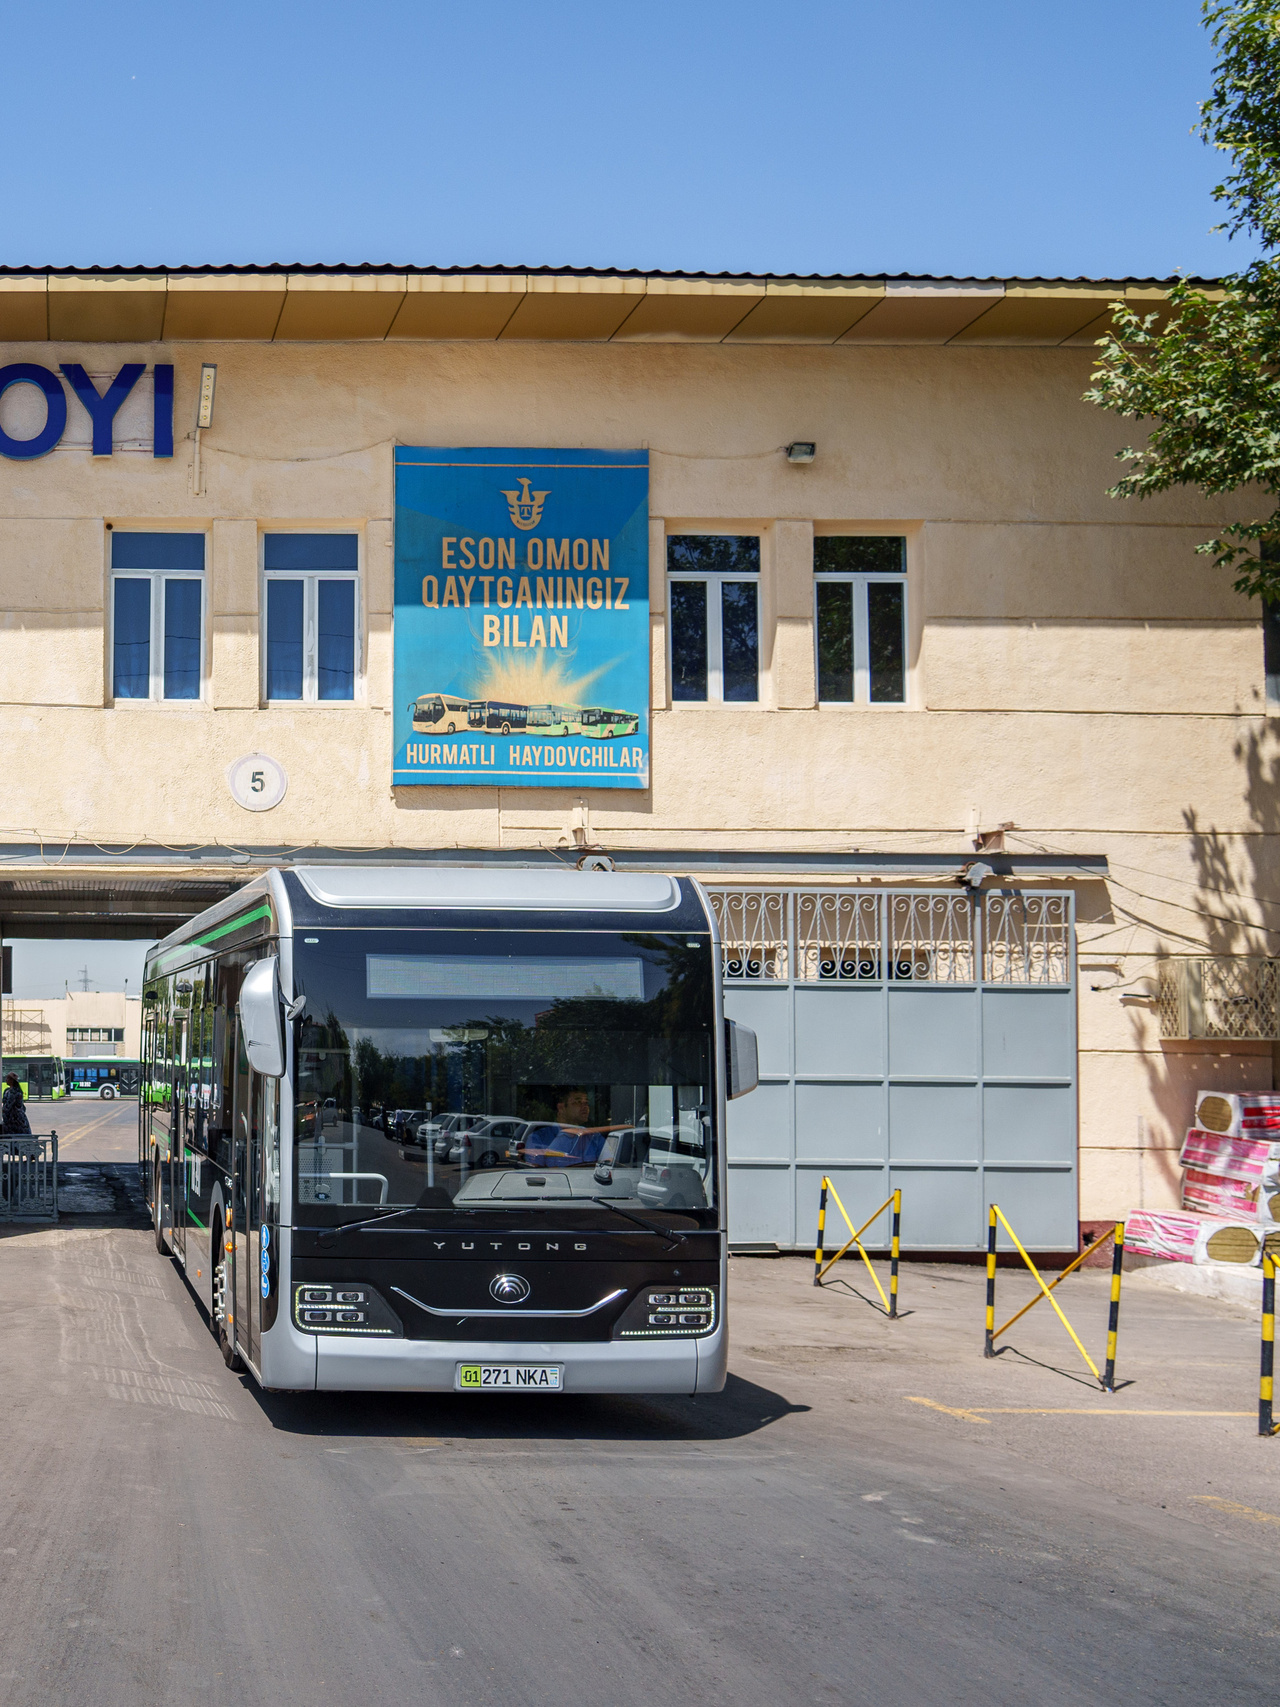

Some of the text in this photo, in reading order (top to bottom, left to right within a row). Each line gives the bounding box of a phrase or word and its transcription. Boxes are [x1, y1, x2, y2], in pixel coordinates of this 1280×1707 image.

[442, 536, 610, 571] ESON OMON
[421, 574, 630, 610] QAYTGANINGIZ
[483, 614, 568, 648] BILAN
[406, 743, 644, 768] HURMATLI HAYDOVCHILAR
[250, 771, 266, 793] 5
[433, 1241, 587, 1251] YUTONG
[482, 1368, 511, 1385] 271
[516, 1369, 549, 1386] NKA
